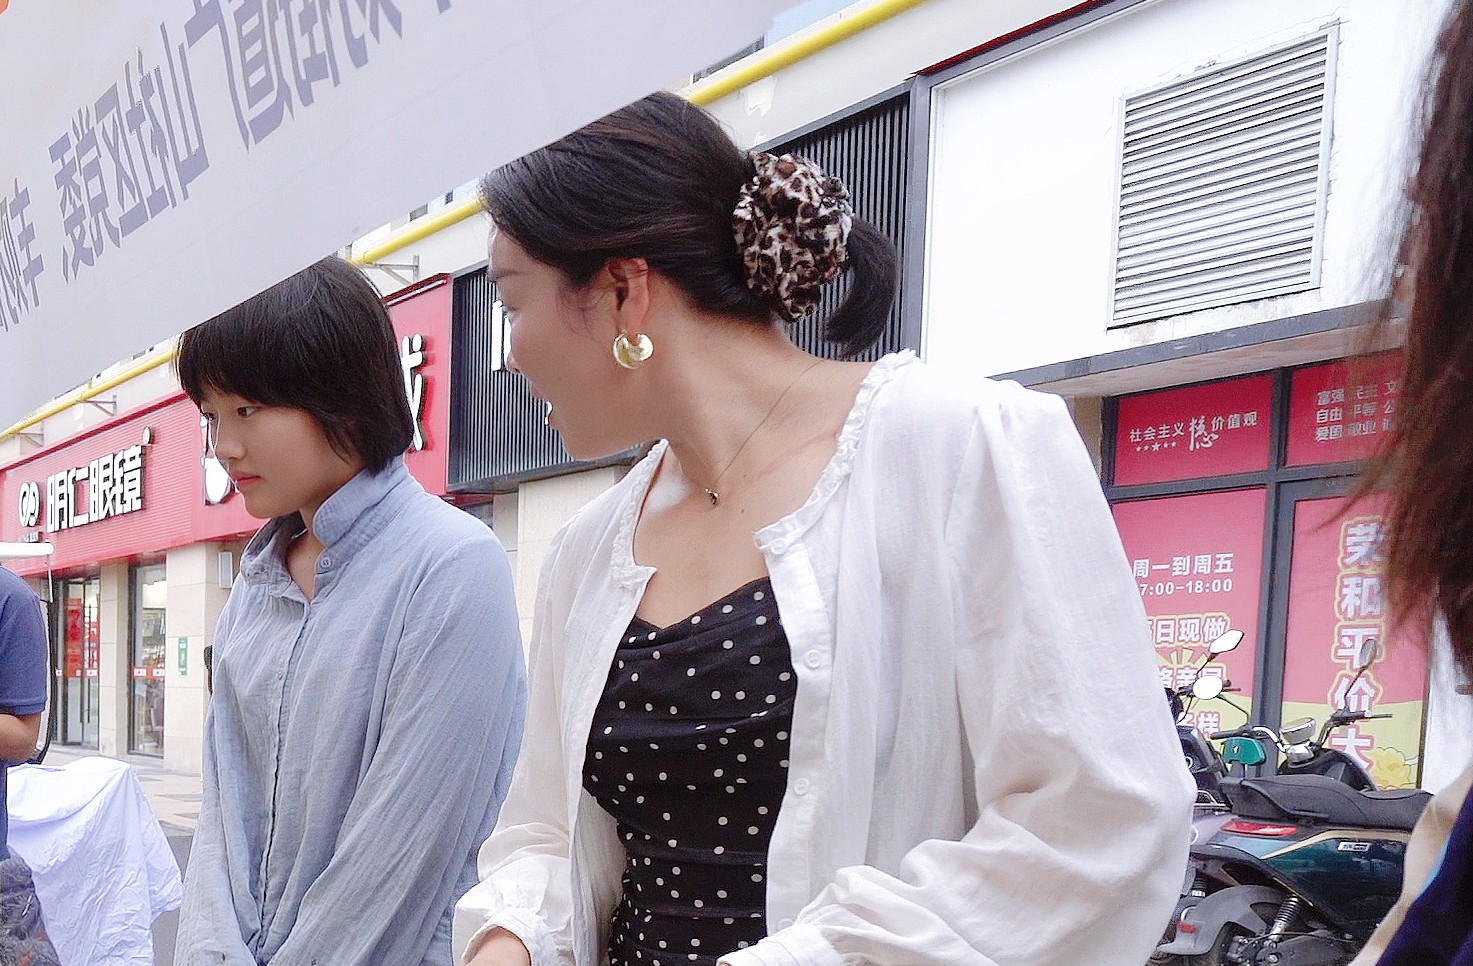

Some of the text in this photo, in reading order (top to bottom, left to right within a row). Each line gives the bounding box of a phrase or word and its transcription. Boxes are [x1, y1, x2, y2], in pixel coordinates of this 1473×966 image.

[1316, 406, 1343, 423] 自由
[47, 445, 142, 533] 明仁眼镜
[1132, 553, 1234, 578] 周一到周五
